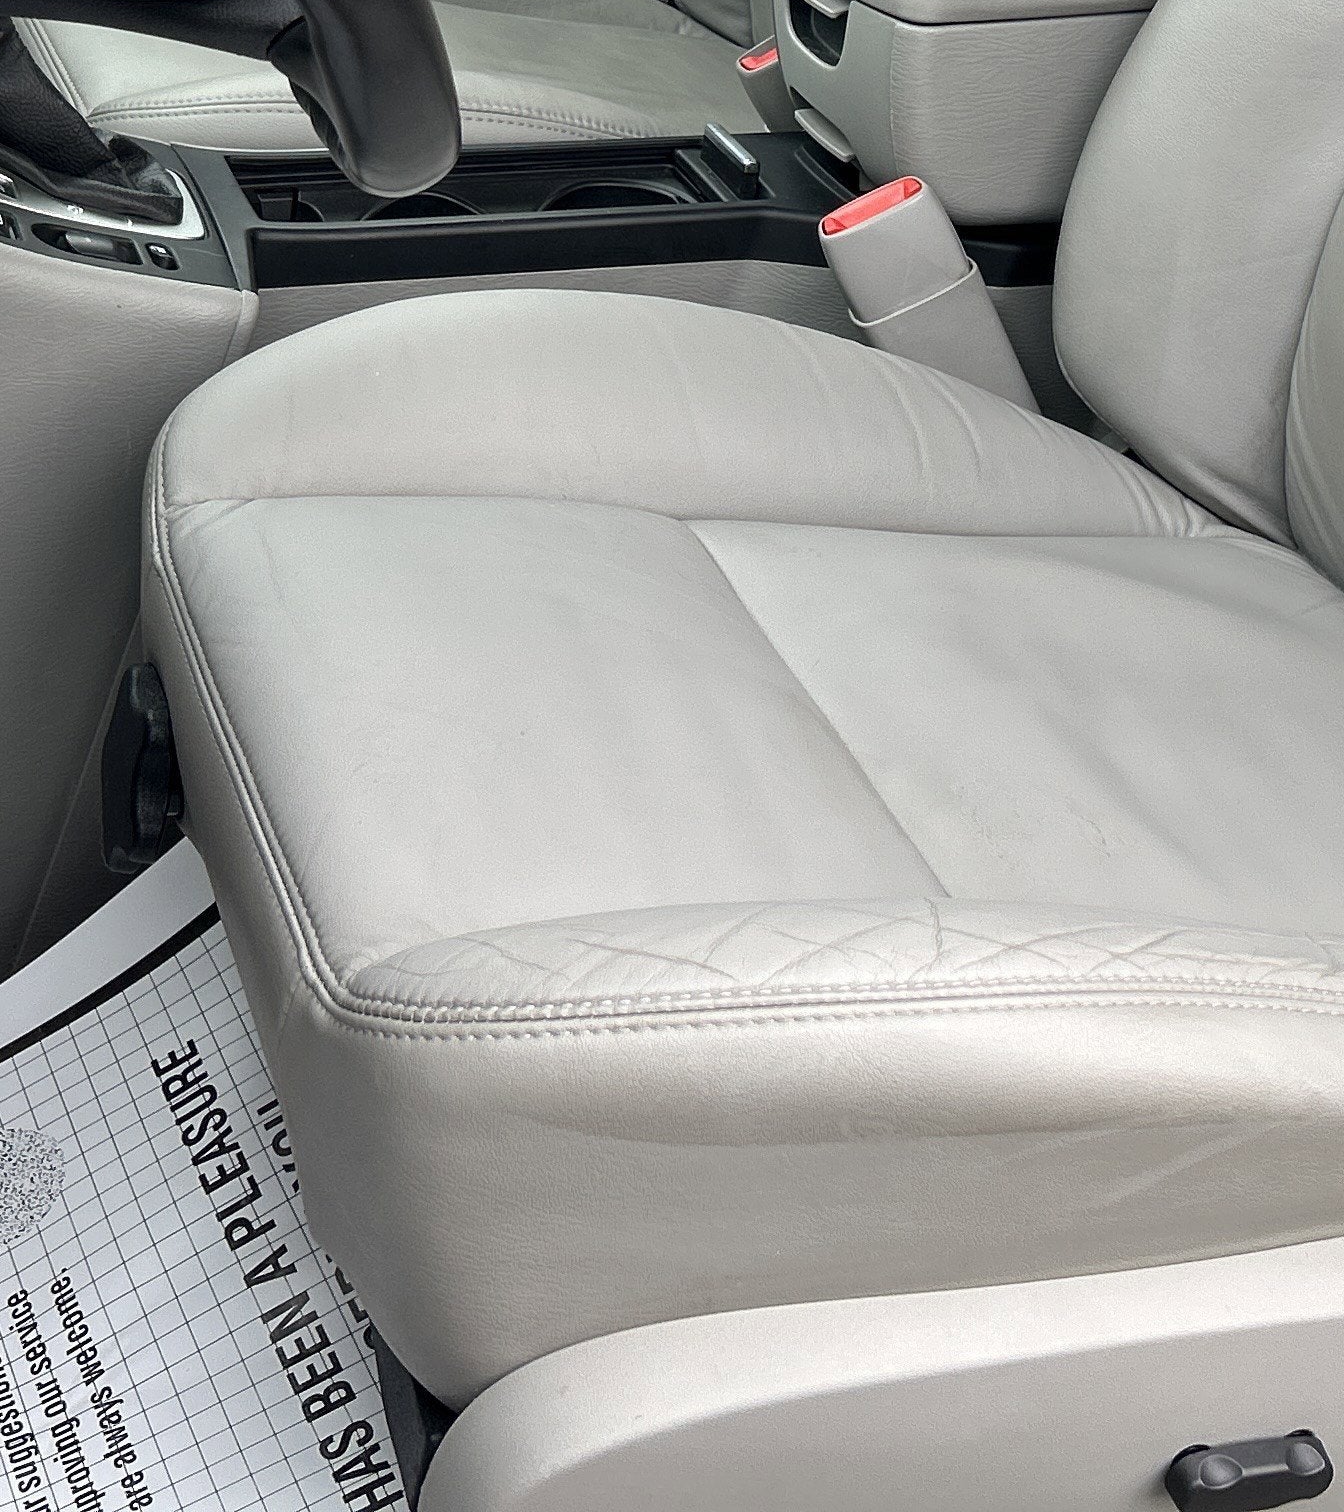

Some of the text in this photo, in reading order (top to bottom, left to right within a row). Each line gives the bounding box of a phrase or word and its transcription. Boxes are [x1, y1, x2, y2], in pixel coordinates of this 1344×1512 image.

[151, 1039, 277, 1251] PLEASURE
[243, 1244, 298, 1289] A
[7, 1289, 52, 1376] service
[260, 1290, 357, 1423] BEEN
[35, 1378, 67, 1418] our
[50, 1267, 154, 1512] are always welcome.
[318, 1419, 405, 1512] HAS
